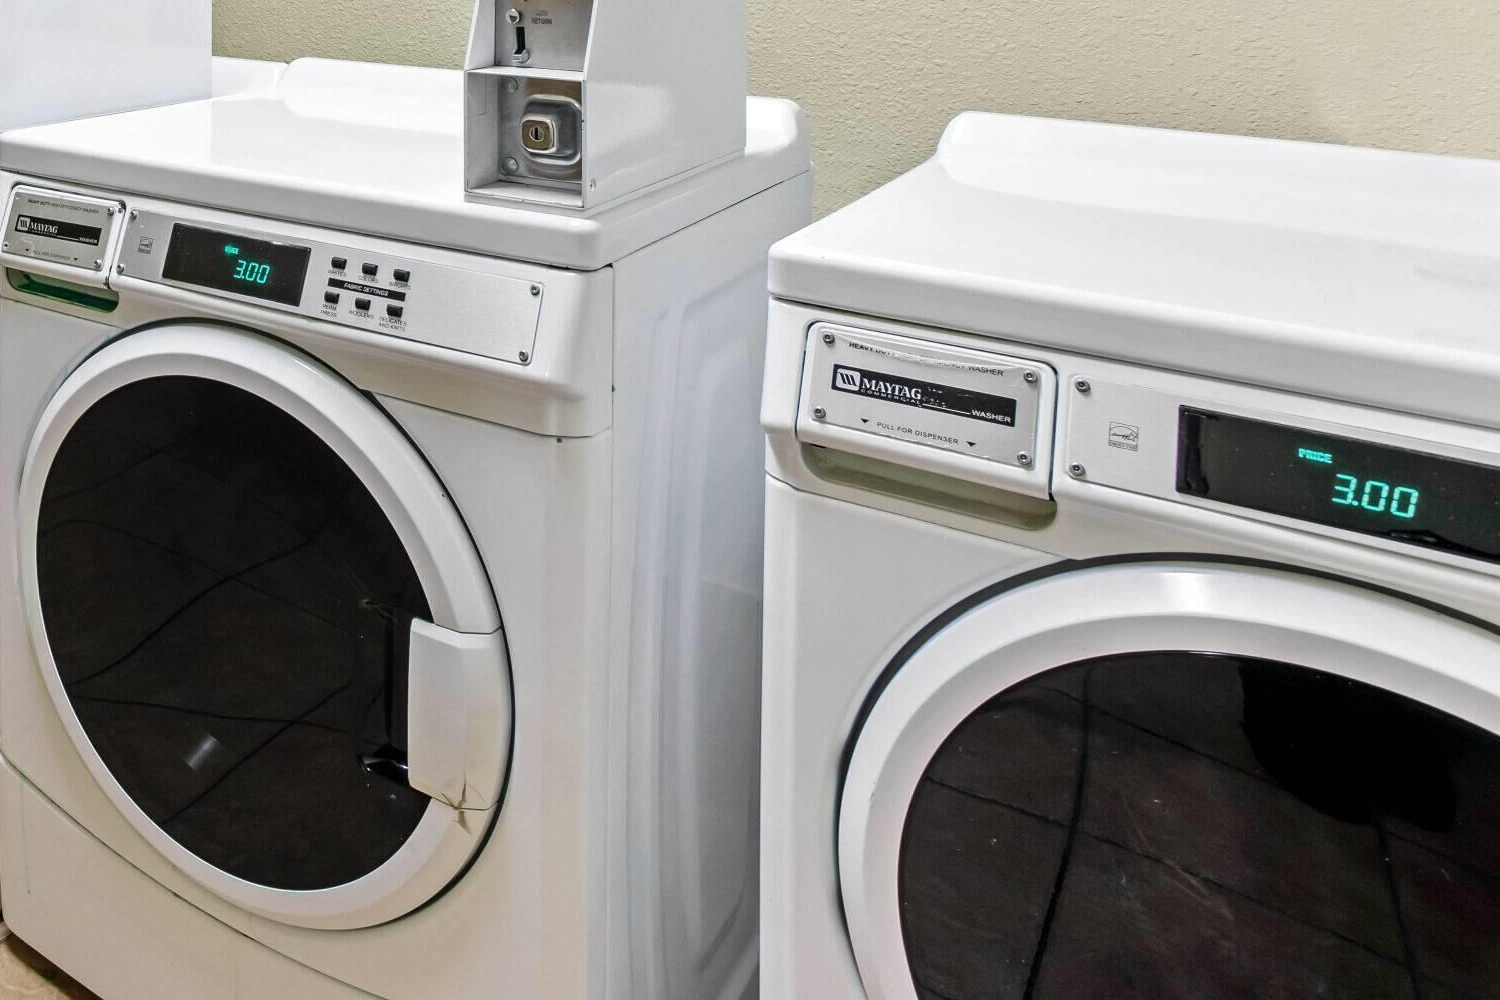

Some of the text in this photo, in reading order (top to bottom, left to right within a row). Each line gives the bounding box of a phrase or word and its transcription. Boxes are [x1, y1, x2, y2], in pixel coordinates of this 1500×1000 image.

[30, 221, 58, 233] MAYTAG
[234, 260, 270, 283] 3.00
[344, 283, 388, 296] FABRIC SETTINGS
[861, 378, 921, 399] MAYTAG
[971, 409, 1011, 423] WASHER
[877, 422, 959, 444] PULL FOR DISPENSER
[1298, 447, 1333, 463] PRICE
[1332, 473, 1419, 519] 3.00
